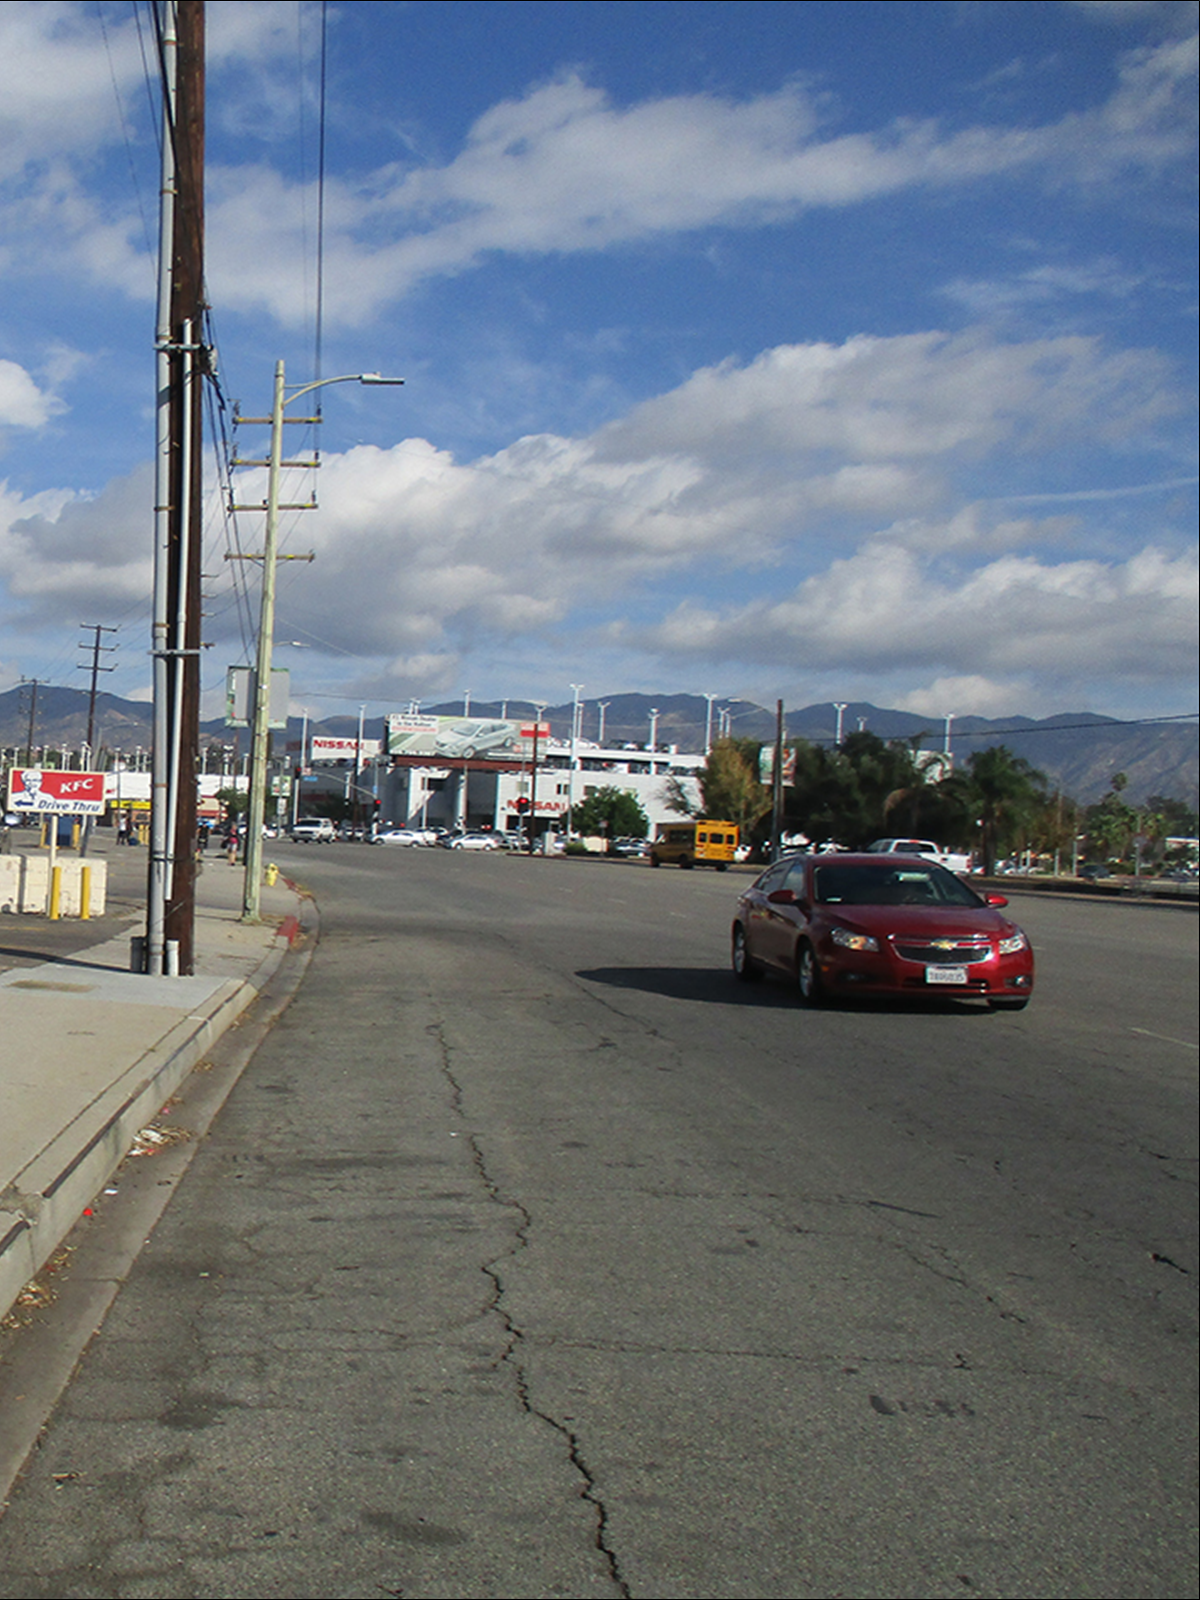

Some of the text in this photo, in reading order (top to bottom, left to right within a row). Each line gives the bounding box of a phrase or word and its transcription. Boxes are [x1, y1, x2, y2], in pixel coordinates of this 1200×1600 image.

[60, 778, 94, 794] KFC
[38, 800, 100, 812] Drive Thru
